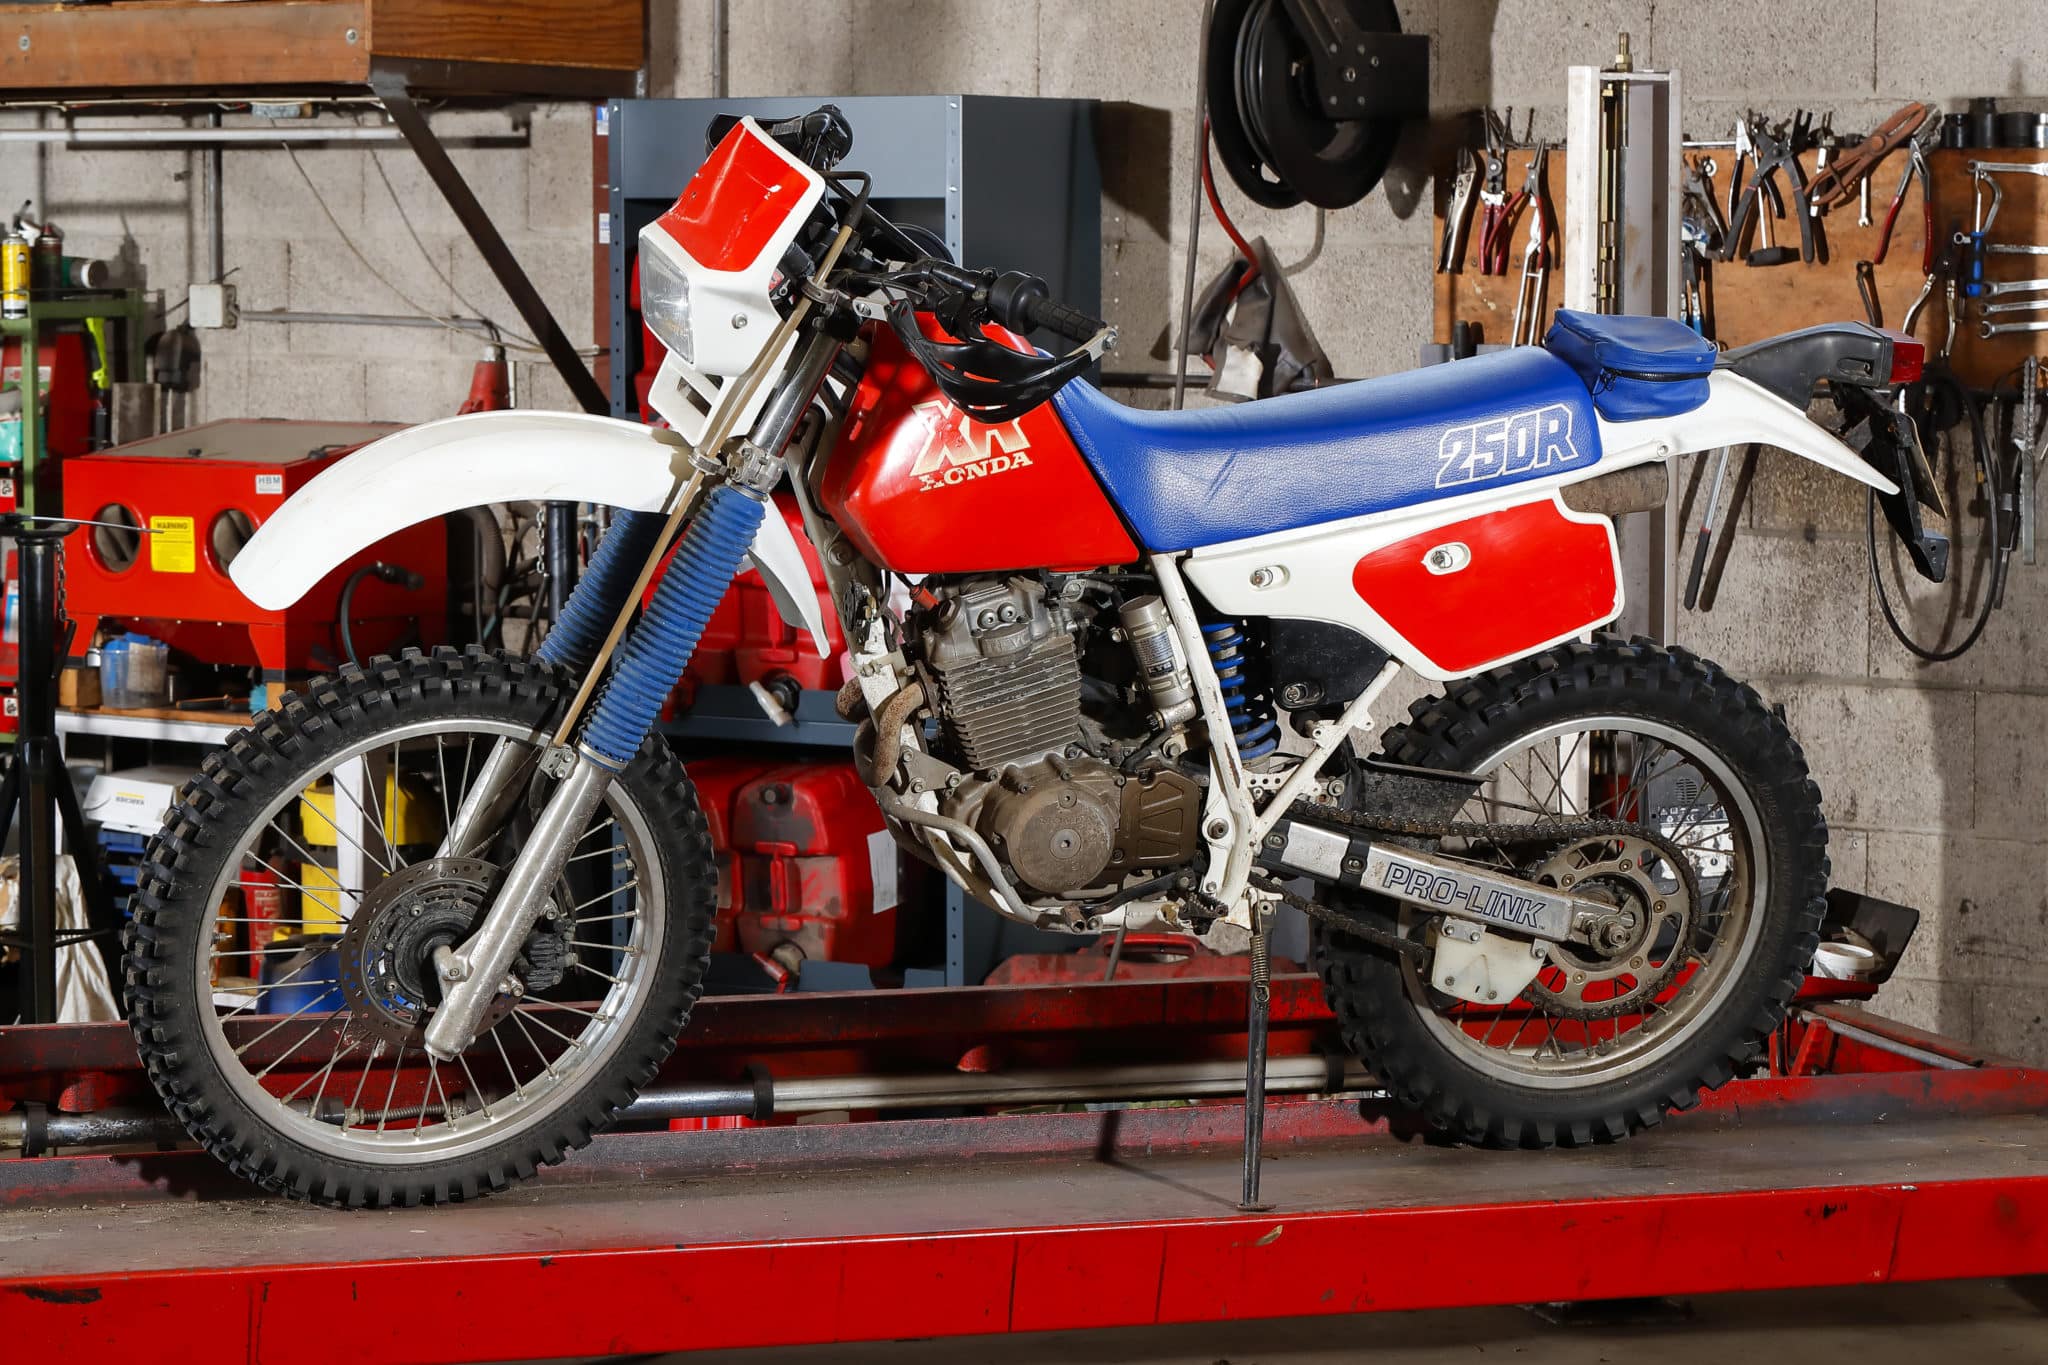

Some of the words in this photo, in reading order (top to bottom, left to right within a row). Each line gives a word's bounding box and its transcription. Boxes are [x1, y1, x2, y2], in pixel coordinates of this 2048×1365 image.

[1435, 403, 1578, 489] 250R
[258, 476, 281, 485] HBM
[1382, 862, 1546, 929] PRO-LINK
